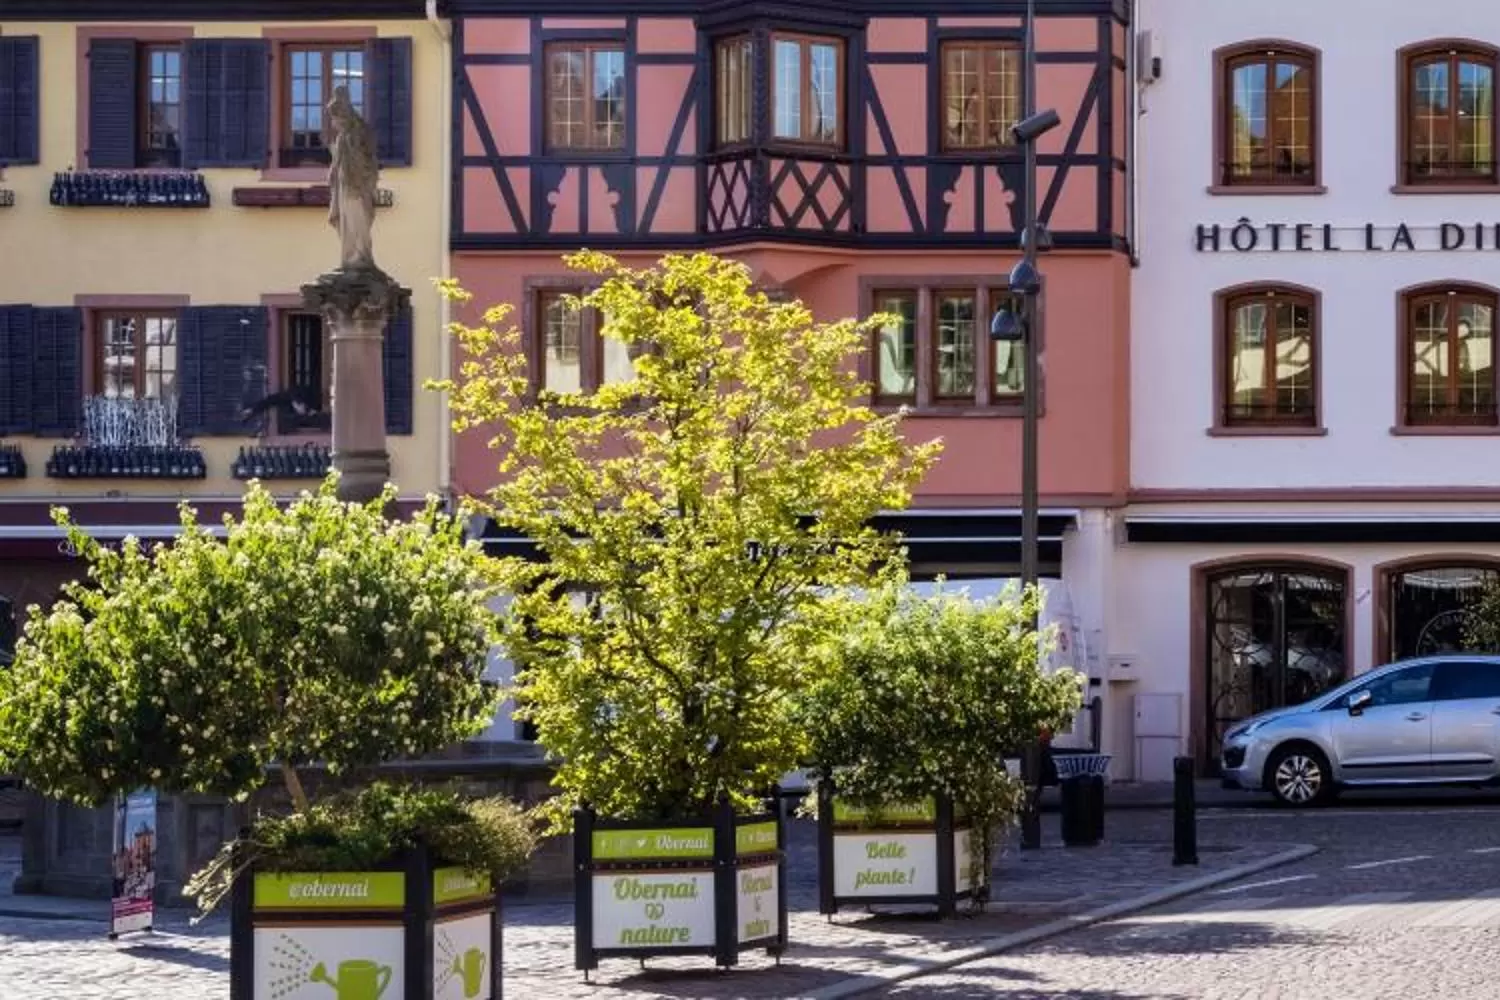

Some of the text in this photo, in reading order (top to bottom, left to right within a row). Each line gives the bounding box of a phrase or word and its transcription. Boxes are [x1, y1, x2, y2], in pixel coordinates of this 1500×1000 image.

[1197, 217, 1340, 252] HÔTEL
[1364, 222, 1416, 252] LA
[866, 841, 907, 858] Belle
[613, 877, 698, 901] Obernai
[620, 924, 691, 944] nature
